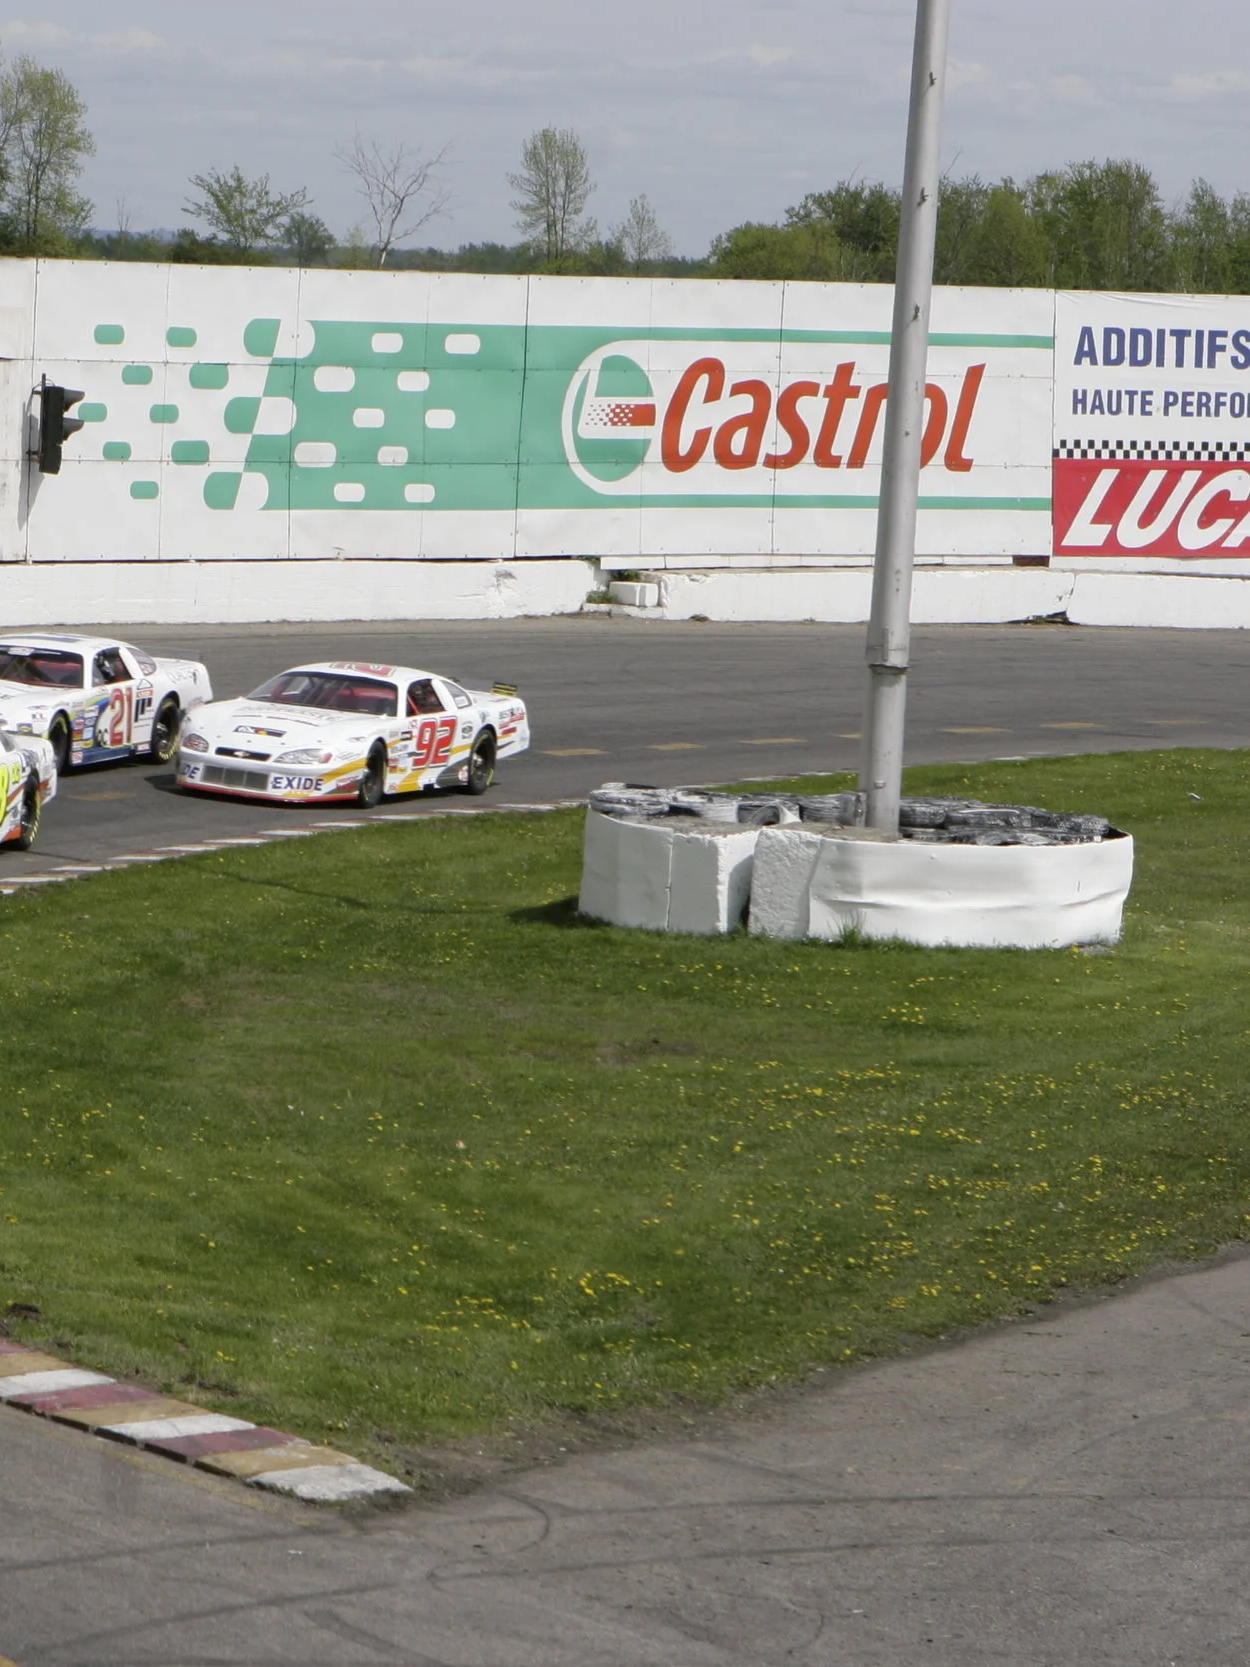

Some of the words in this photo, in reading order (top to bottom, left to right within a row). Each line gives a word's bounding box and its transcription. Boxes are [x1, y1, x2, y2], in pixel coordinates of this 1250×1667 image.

[1073, 326, 1250, 370] ADDITIFS
[1071, 388, 1154, 417] HAUTE
[1163, 390, 1250, 418] PERFO
[110, 687, 133, 747] 21
[411, 715, 459, 771] 92
[272, 776, 324, 791] EXIDE
